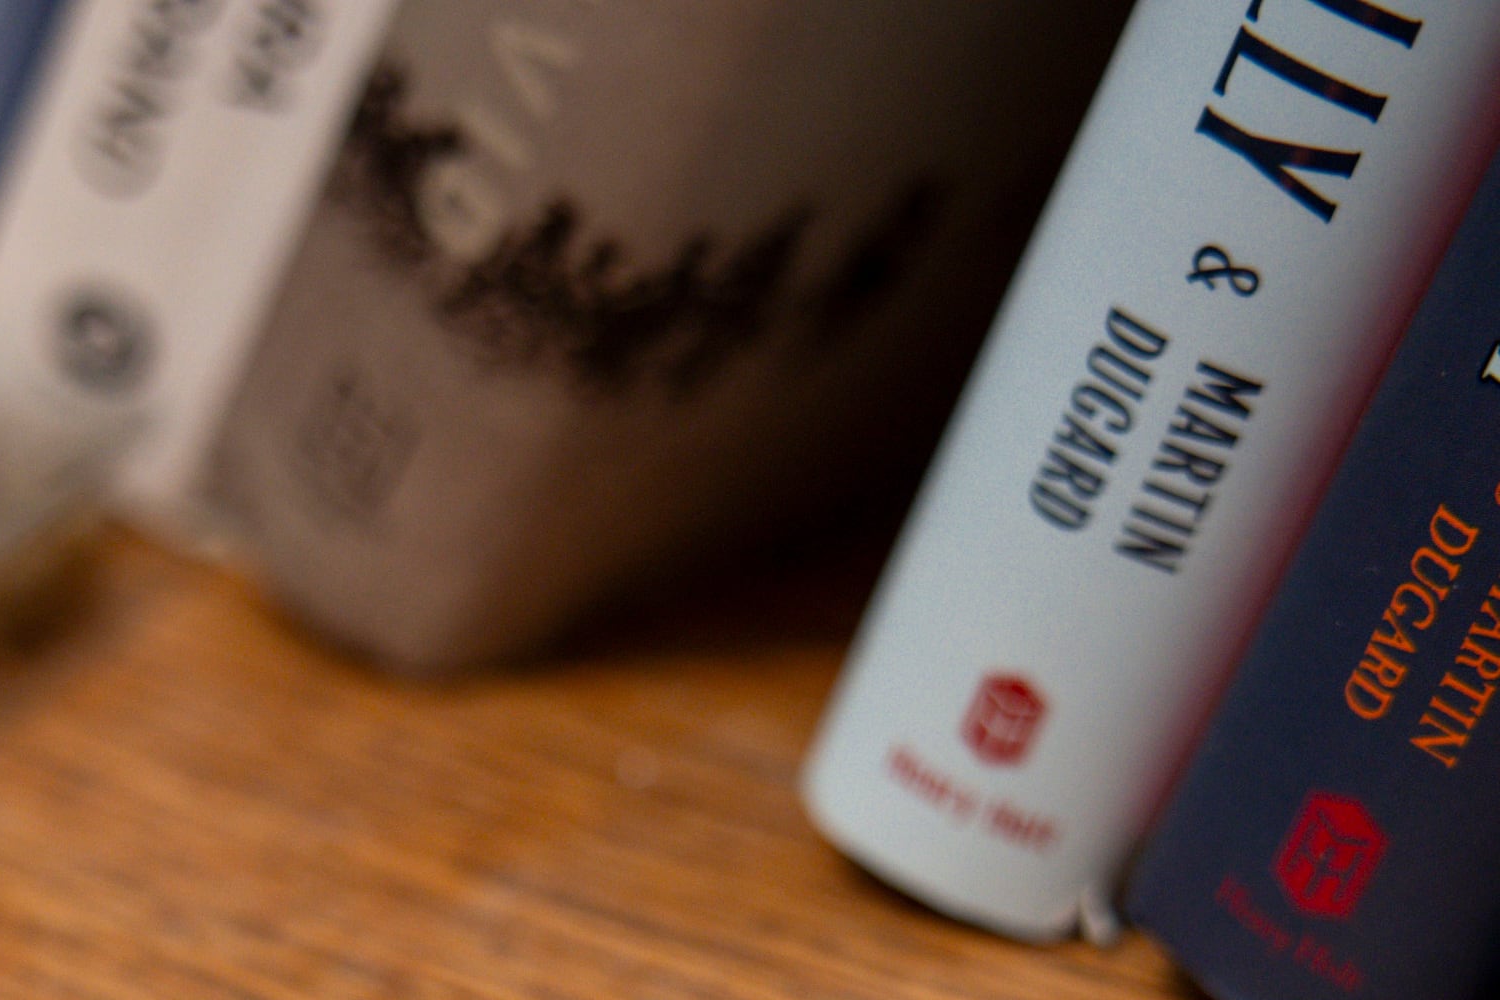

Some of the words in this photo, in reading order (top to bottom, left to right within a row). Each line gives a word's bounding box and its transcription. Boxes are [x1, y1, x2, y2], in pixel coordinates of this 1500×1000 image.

[1185, 244, 1261, 298] &
[1027, 307, 1170, 533] DUGARD
[1114, 360, 1265, 575] MARTIN
[1344, 503, 1480, 720] DUGARD
